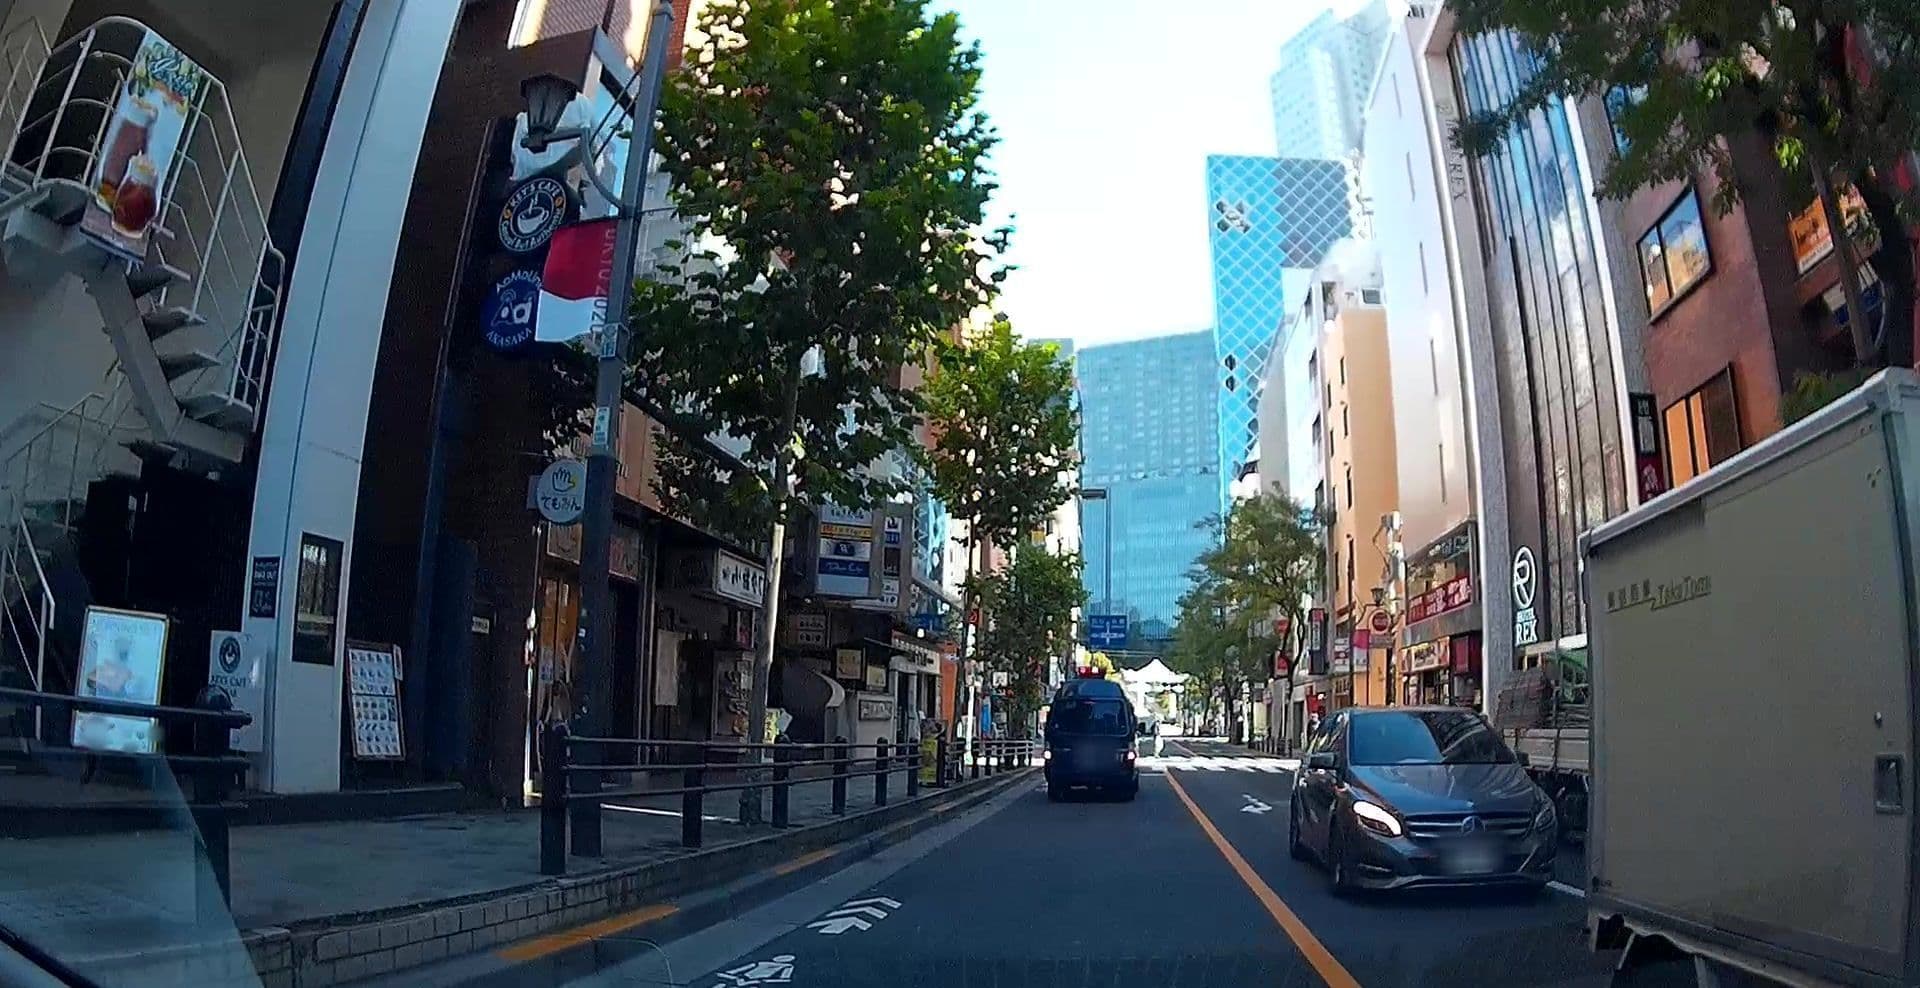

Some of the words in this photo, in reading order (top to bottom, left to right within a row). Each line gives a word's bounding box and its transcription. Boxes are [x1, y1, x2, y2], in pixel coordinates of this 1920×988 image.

[538, 181, 561, 198] CAFE
[541, 496, 582, 511] てもみん
[1515, 620, 1539, 646] REX
